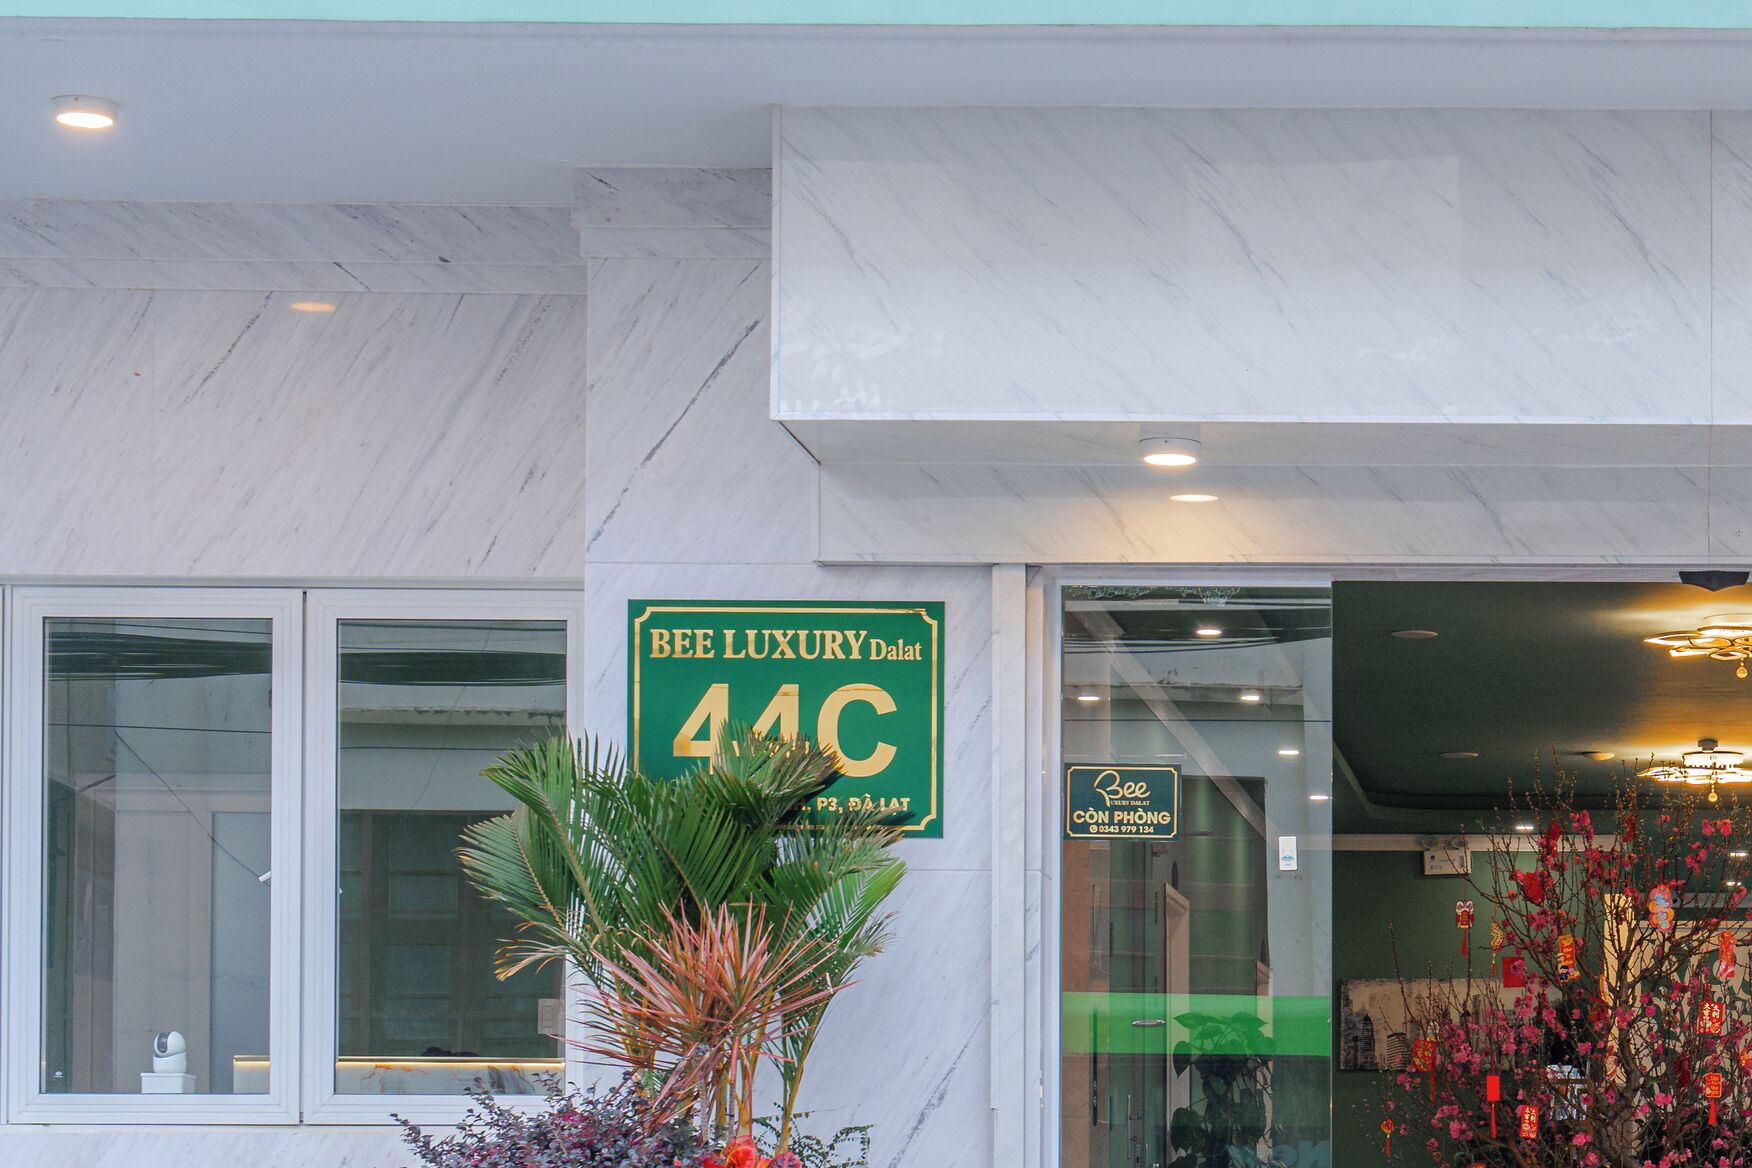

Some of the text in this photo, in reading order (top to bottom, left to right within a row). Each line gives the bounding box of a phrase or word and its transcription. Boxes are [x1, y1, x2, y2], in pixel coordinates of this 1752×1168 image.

[650, 629, 922, 661] BEE LUXURY Dalat
[672, 683, 898, 778] 44C
[1093, 770, 1151, 807] Bee
[817, 797, 843, 814] P3,
[1072, 807, 1171, 824] CÒN PHÒNG
[1099, 825, 1119, 833] 0343
